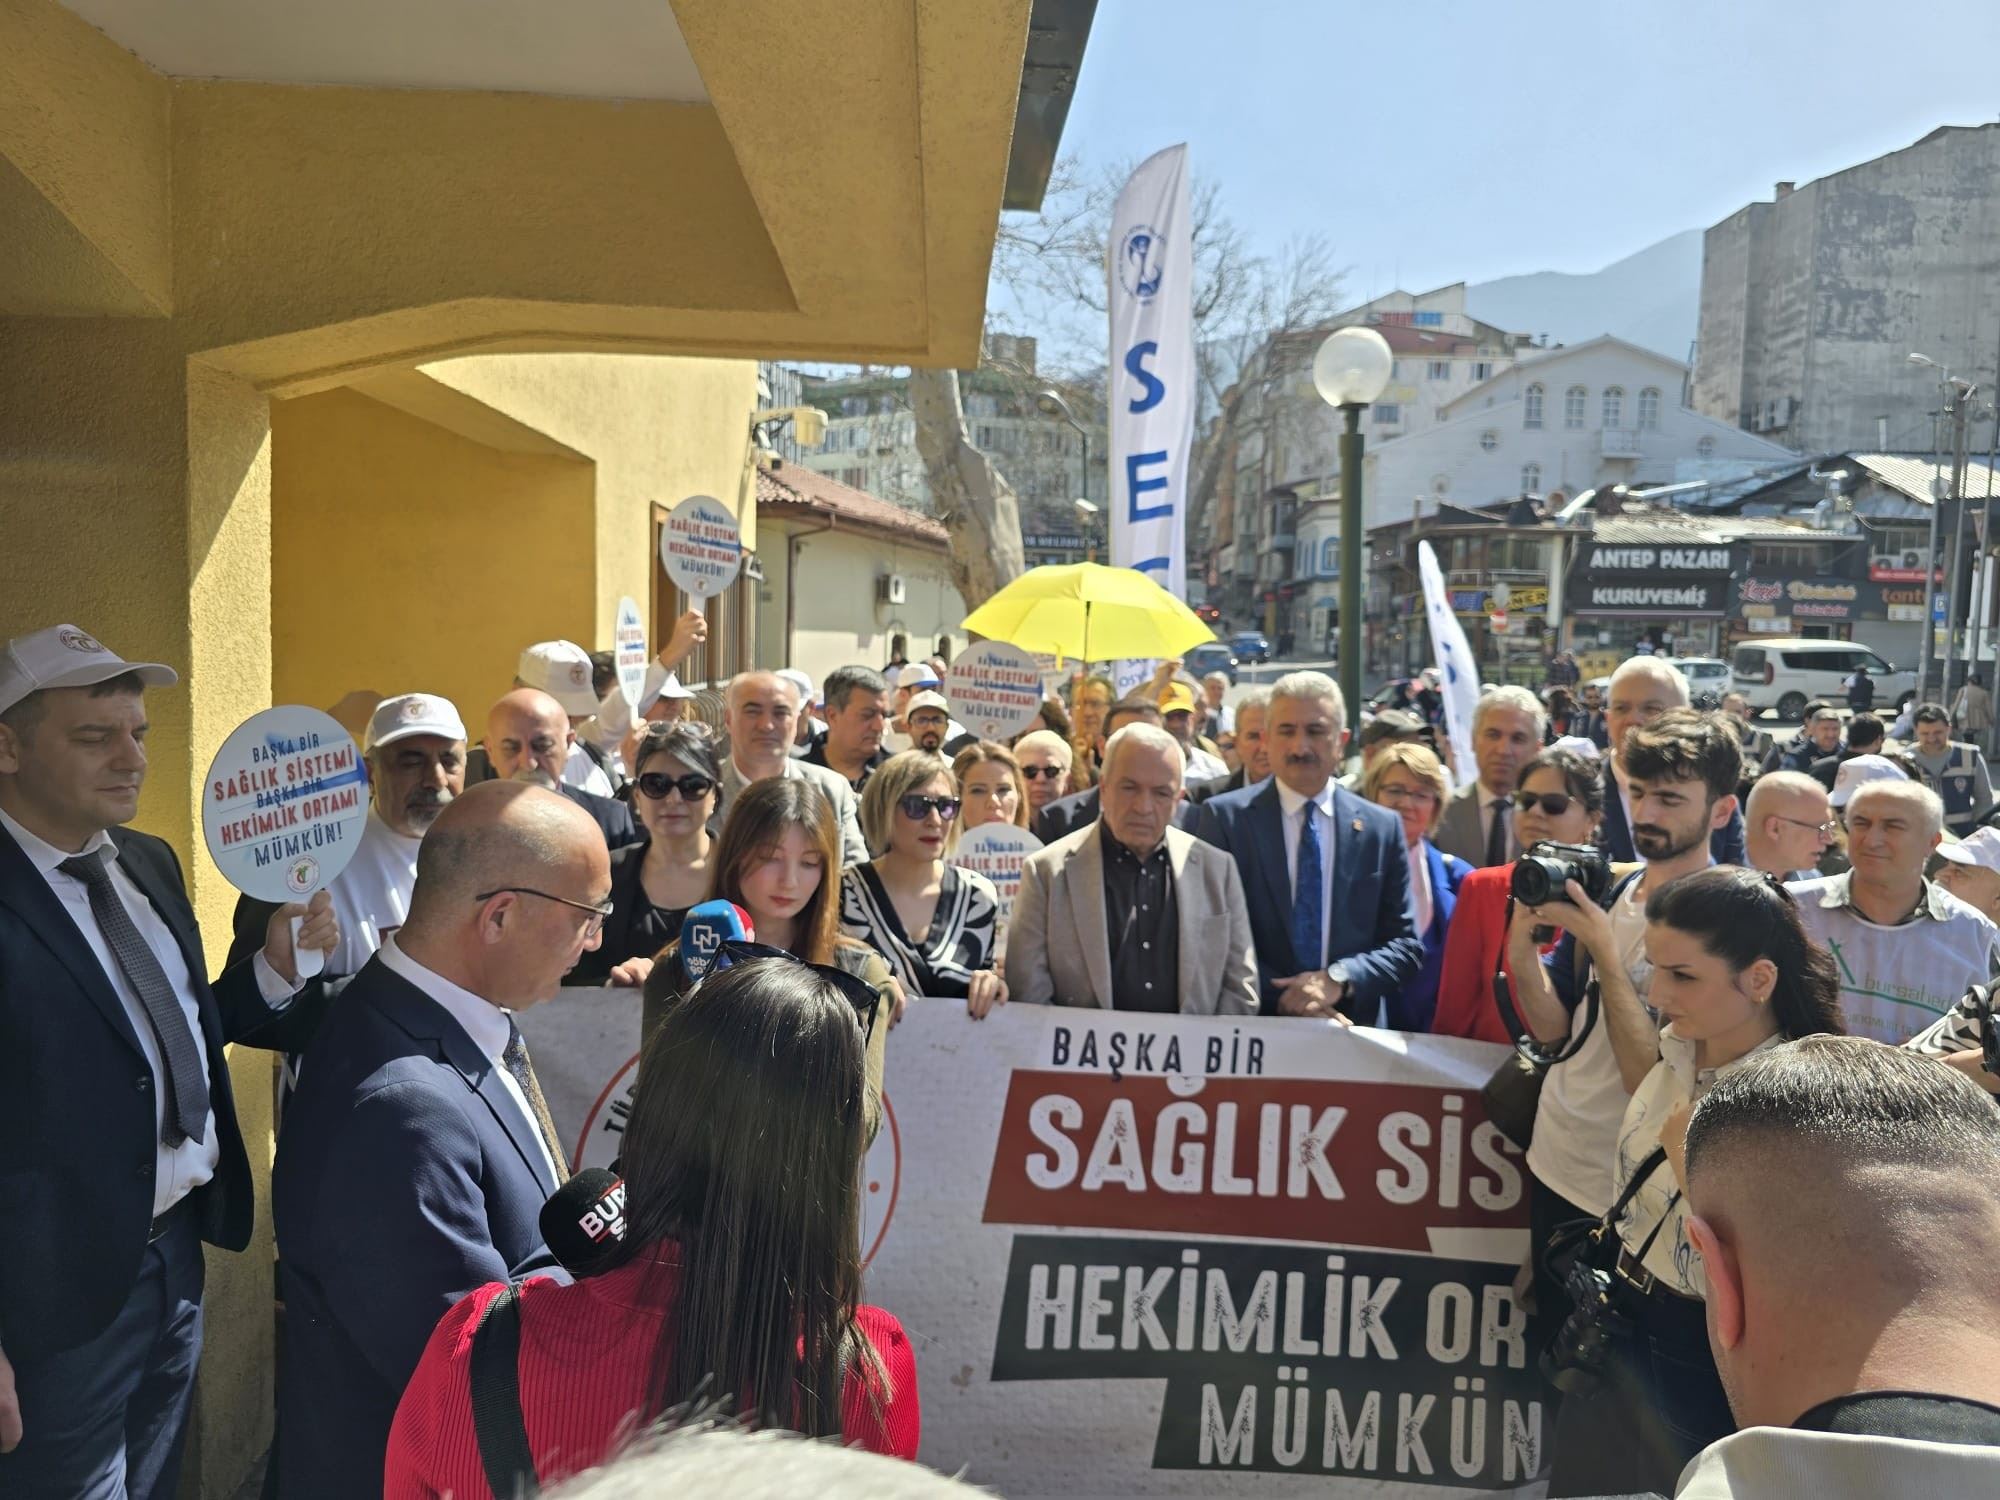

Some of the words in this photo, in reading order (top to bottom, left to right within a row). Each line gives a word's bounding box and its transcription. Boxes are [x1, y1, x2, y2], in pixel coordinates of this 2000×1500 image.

[1589, 548, 1655, 568] ANTEP
[1660, 549, 1730, 569] PAZARI
[1591, 584, 1707, 608] KURUYEMİŞ
[214, 766, 280, 802] SAĞLIK
[286, 744, 353, 780] SİSTEMİ
[252, 741, 294, 763] BAŞKA
[299, 731, 320, 751] BİR
[221, 805, 298, 846] HEKİMLİK
[303, 788, 358, 820] ORTAMI
[256, 785, 298, 809] BAŞKA
[254, 821, 343, 867] MÜMKÜN!
[1053, 1027, 1182, 1081] BAŞKA
[1205, 1029, 1265, 1075] BİR
[1024, 1075, 1348, 1200] SAĞLIK
[1375, 1096, 1524, 1210] SİS
[1025, 1249, 1402, 1361] HEKİMLİK
[1426, 1282, 1527, 1369] OR
[1198, 1366, 1544, 1481] MÜMKÜN
